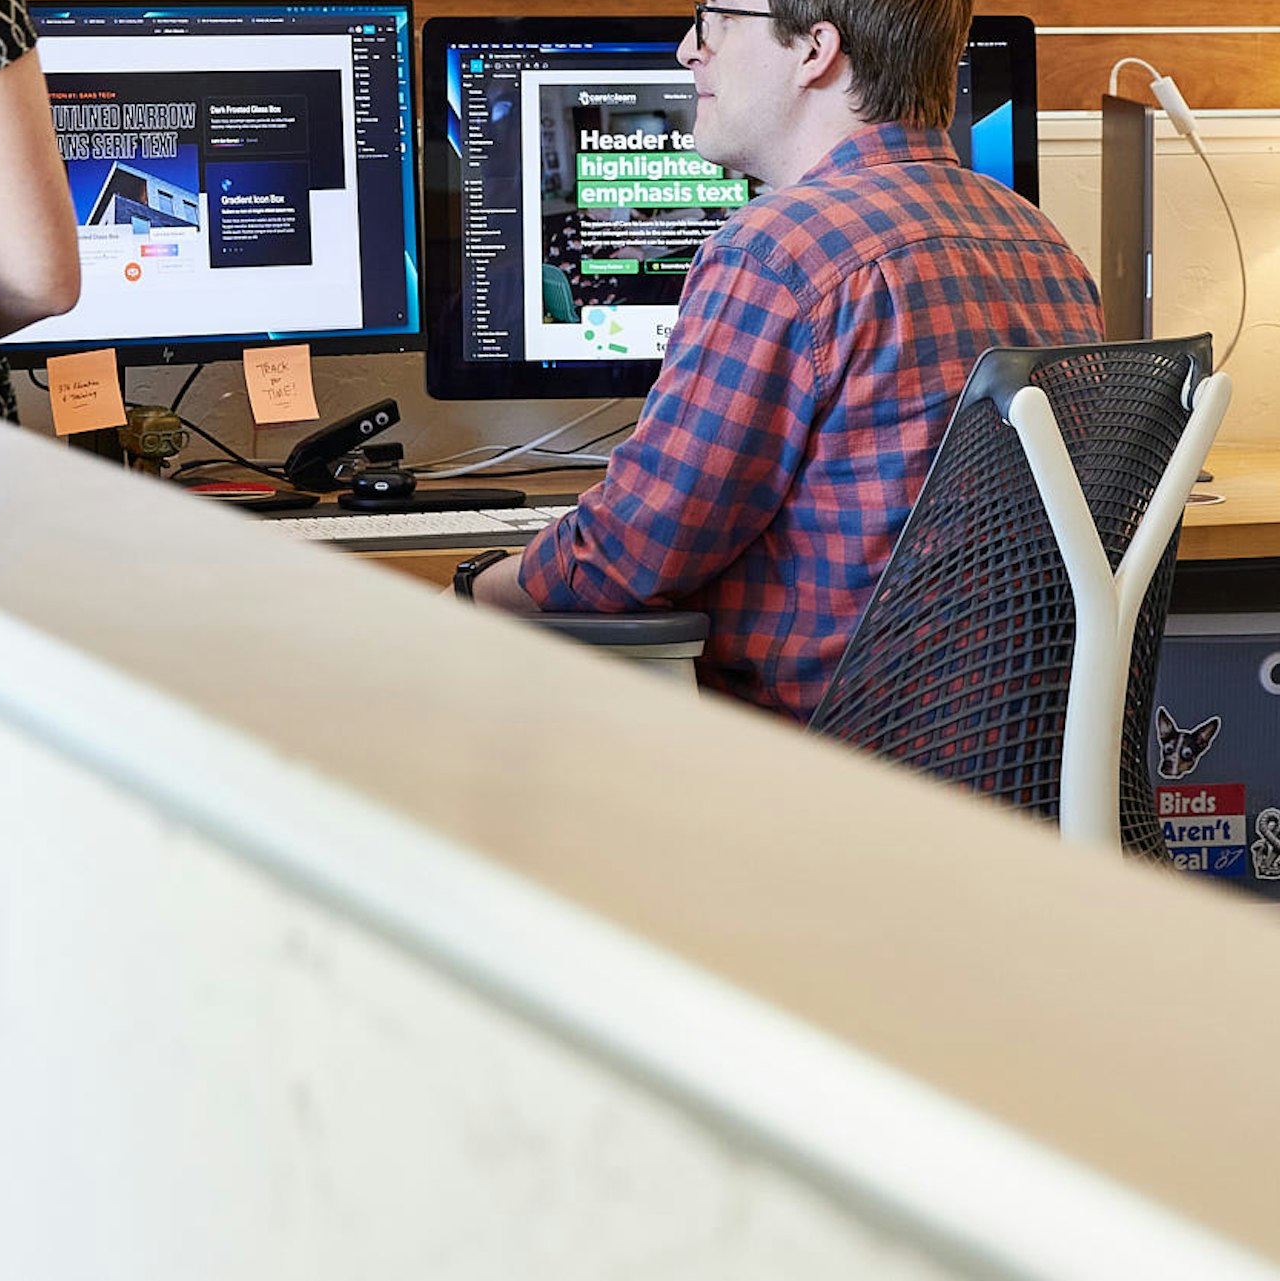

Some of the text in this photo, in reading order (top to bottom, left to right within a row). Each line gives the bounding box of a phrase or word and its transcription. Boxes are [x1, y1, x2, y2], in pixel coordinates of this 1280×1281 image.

[122, 103, 196, 130] NARROW
[91, 132, 138, 159] SERIF
[139, 131, 178, 158] TEXT
[580, 130, 668, 150] Header
[581, 156, 718, 180] highlighted
[221, 195, 253, 205] Gradient
[581, 181, 744, 206] emphasis text
[1159, 790, 1217, 815] Birds
[1162, 819, 1231, 842] Aren't
